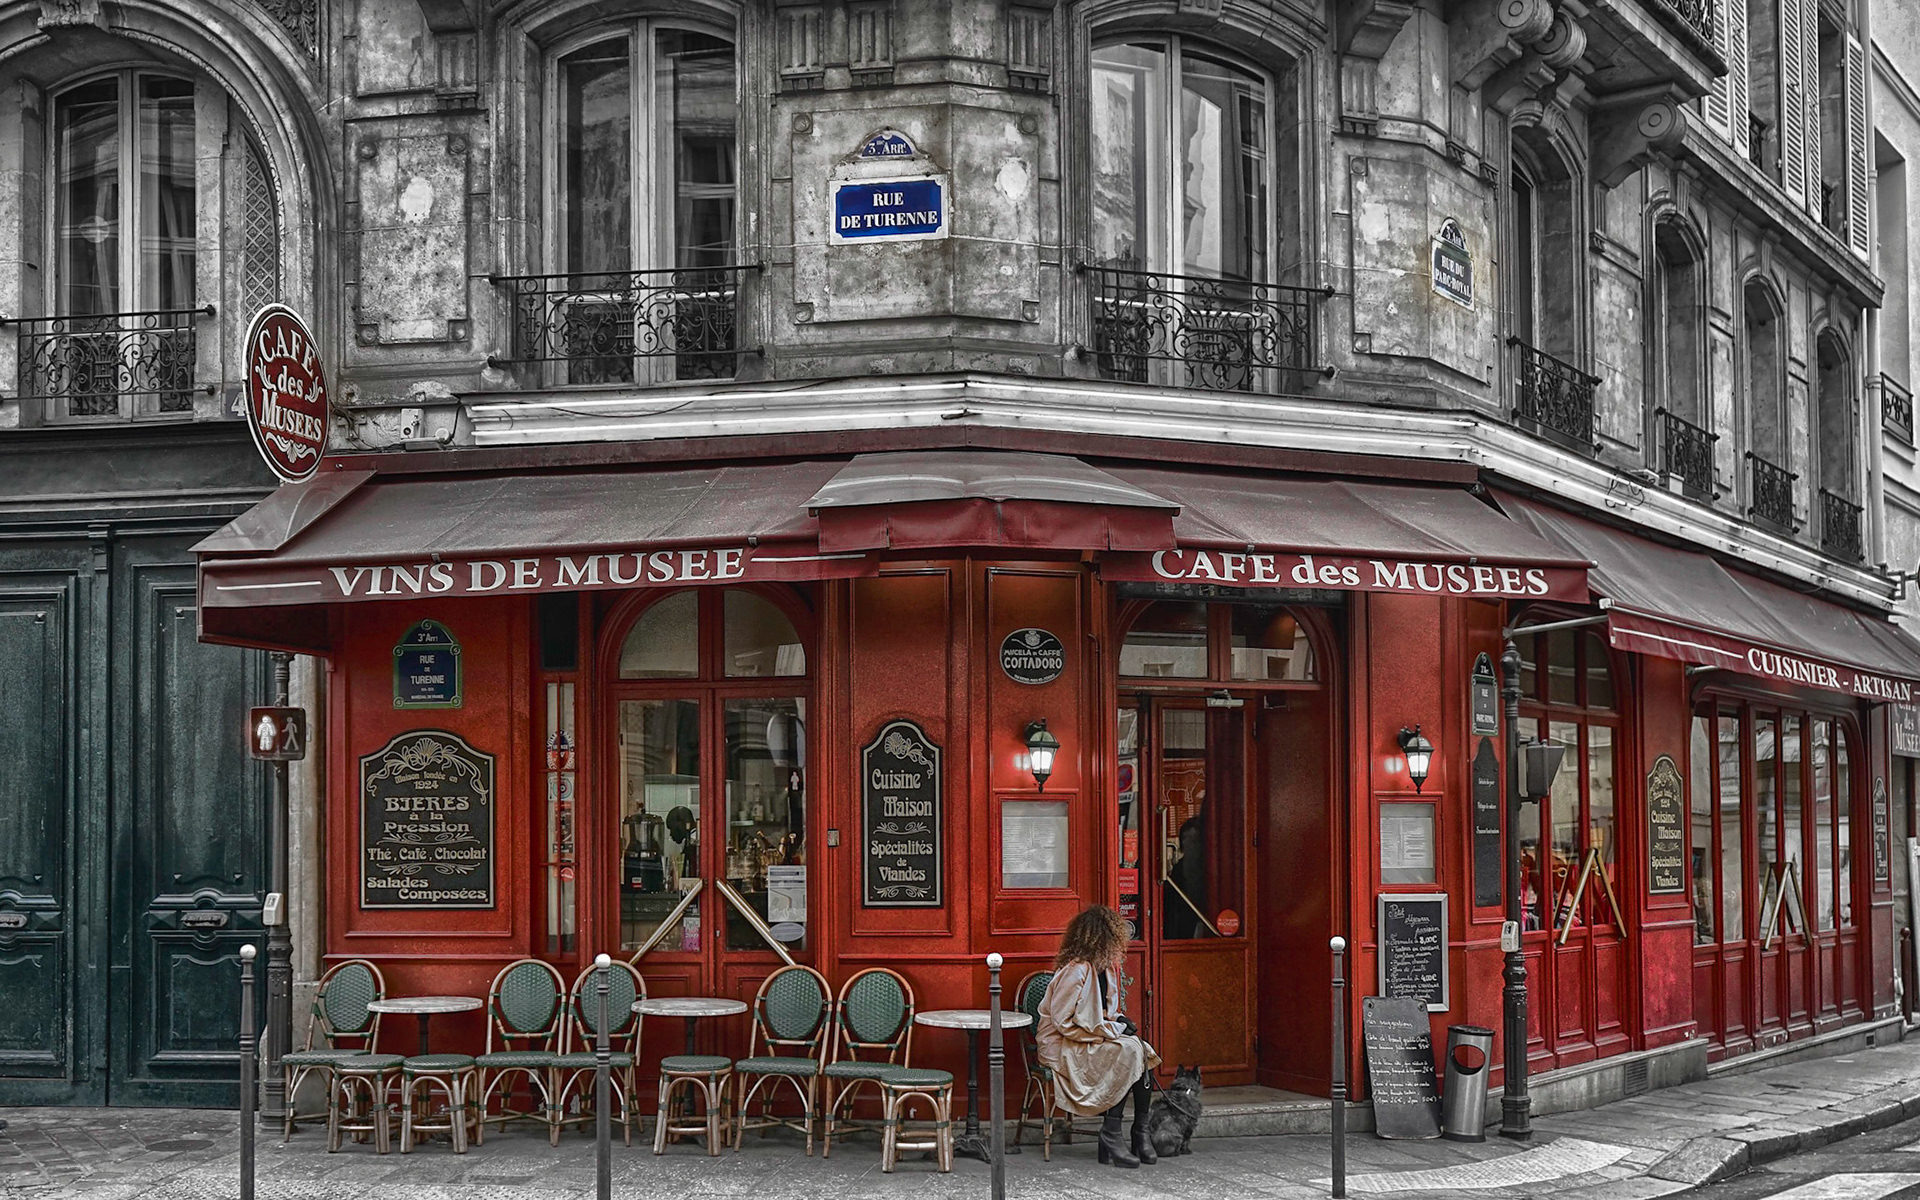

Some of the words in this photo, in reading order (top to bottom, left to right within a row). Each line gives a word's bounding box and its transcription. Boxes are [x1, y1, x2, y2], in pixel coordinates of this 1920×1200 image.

[873, 192, 904, 207] RUE
[841, 215, 861, 229] DE
[864, 211, 938, 228] TURENNE
[1441, 255, 1455, 273] RUE
[1455, 262, 1465, 278] DU
[259, 326, 316, 378] CAFE
[277, 365, 304, 399] des
[260, 388, 323, 443] MUSEES
[328, 561, 454, 596] VINS
[466, 558, 543, 592] DE
[552, 547, 746, 587] MUSEE
[1151, 549, 1281, 584] CAFE
[1291, 554, 1361, 587] des
[1372, 560, 1550, 596] MUSEES
[419, 655, 435, 664] RUE
[1004, 656, 1063, 669] COSTADORO
[411, 675, 445, 685] TURENNE
[1747, 648, 1841, 690] CUISINIER
[1853, 674, 1912, 701] ARTISAN
[413, 780, 439, 790] 1924
[871, 768, 921, 790] Cuisine
[883, 796, 933, 817] Maison
[409, 811, 419, 821] à
[430, 811, 444, 821] la
[1651, 810, 1676, 824] Cuisine
[383, 821, 470, 833] Pression
[1657, 826, 1682, 840] Maison
[434, 846, 487, 860] Chocolat
[871, 840, 933, 859] Spécialités
[896, 857, 907, 867] de
[879, 866, 926, 881] Viandes
[1656, 875, 1679, 887] Viandes
[367, 876, 429, 889] Salades
